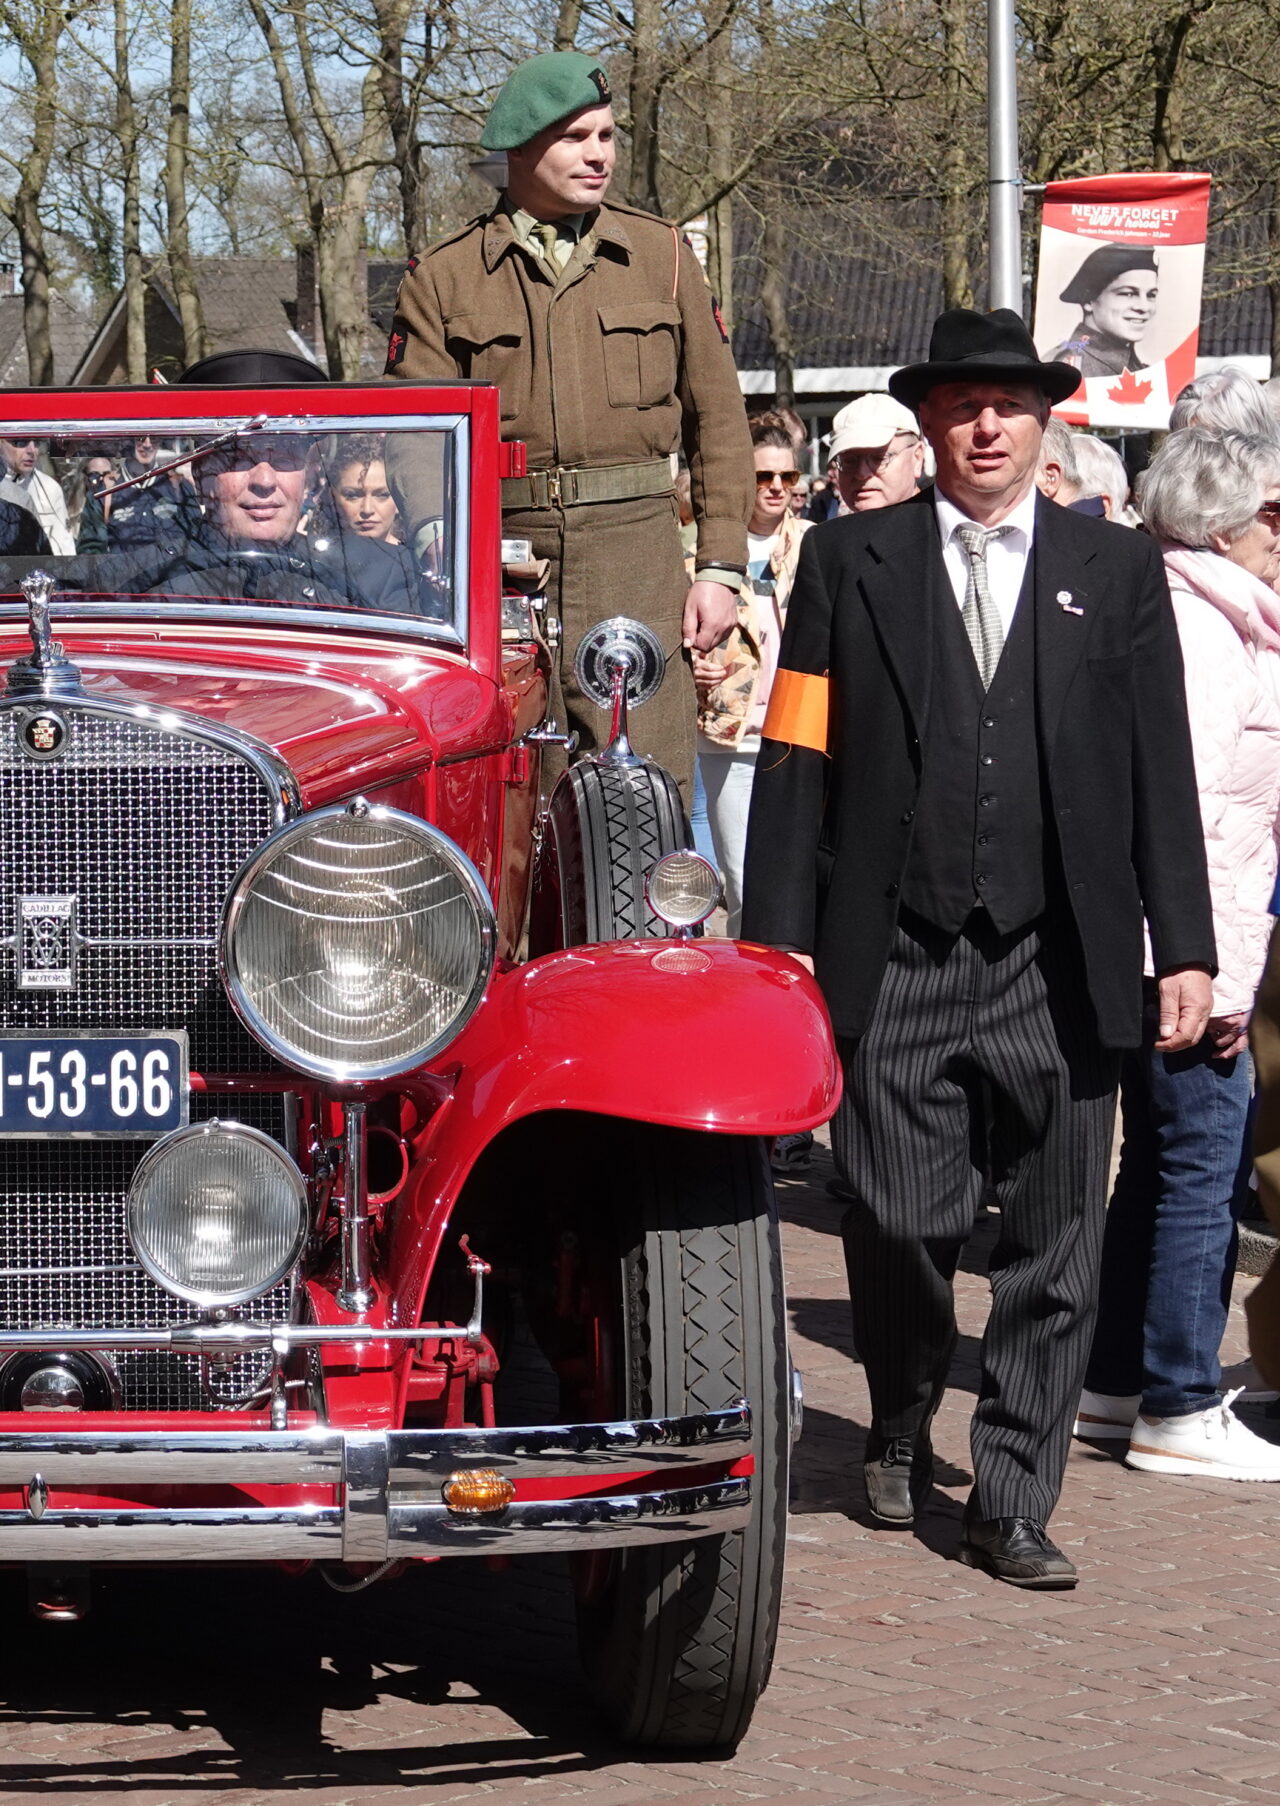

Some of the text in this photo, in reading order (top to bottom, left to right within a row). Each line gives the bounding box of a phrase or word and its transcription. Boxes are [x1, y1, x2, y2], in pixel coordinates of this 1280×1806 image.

[1071, 204, 1179, 221] NEVER FORGET
[23, 903, 71, 914] CADILLAC
[27, 973, 68, 984] MOTORS
